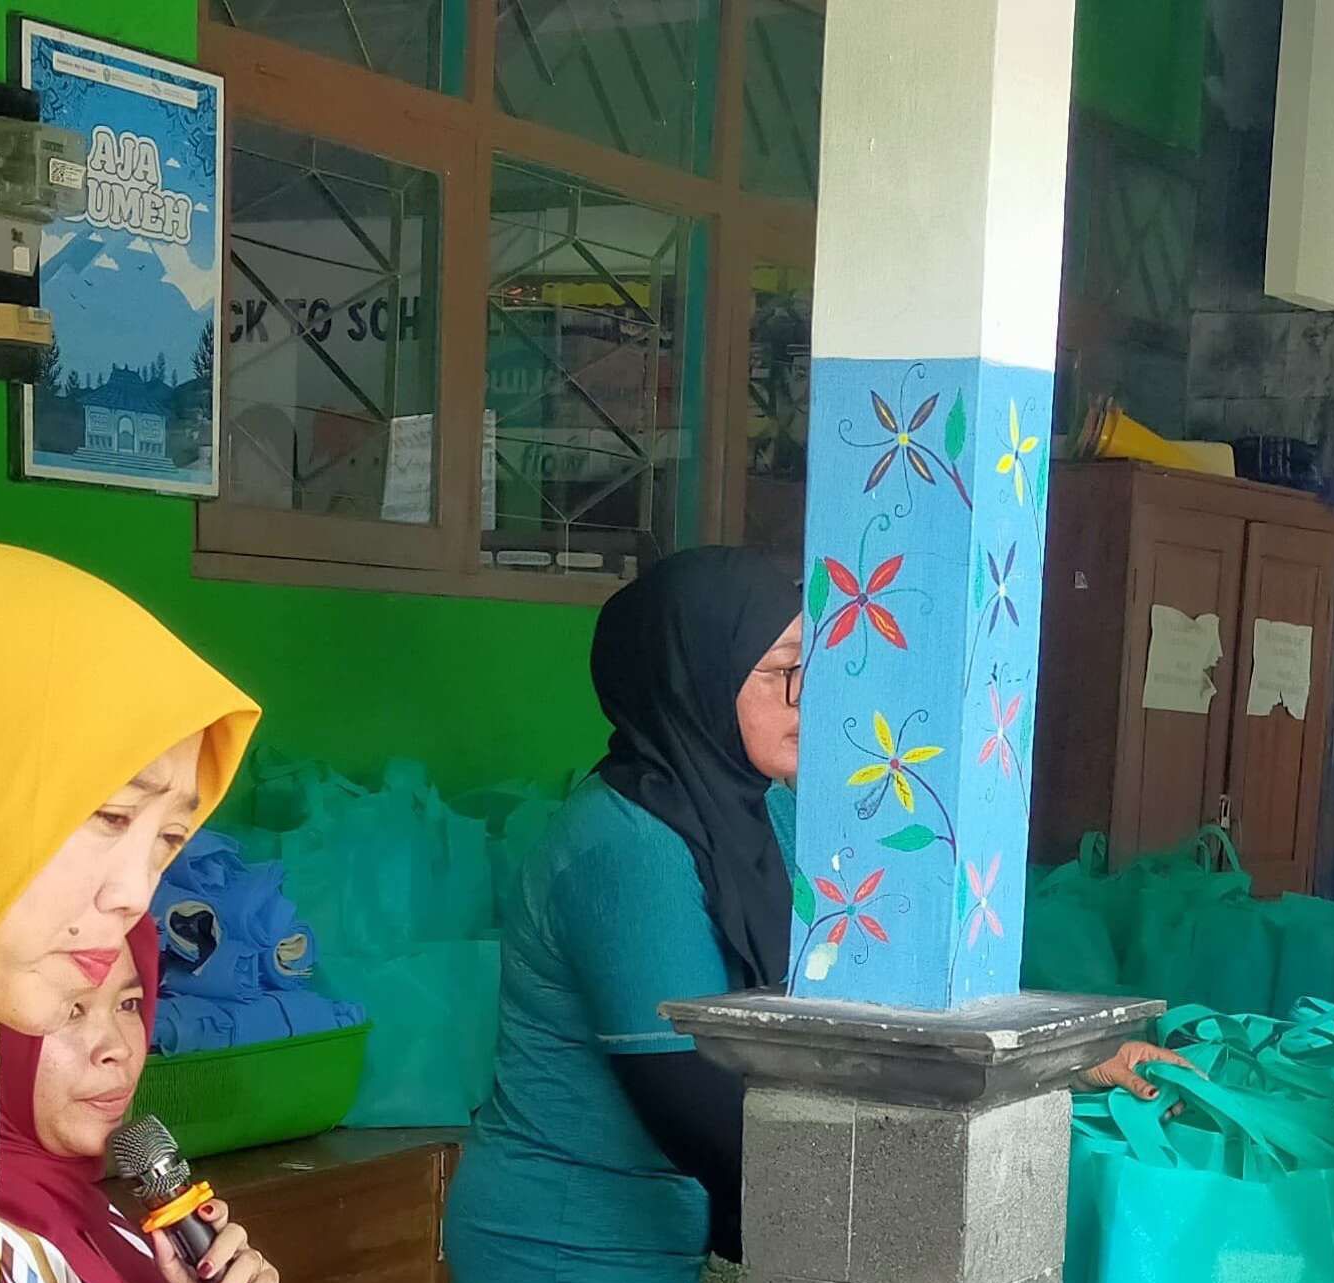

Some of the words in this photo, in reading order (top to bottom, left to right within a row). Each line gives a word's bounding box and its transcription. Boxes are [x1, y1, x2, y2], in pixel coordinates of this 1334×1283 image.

[89, 128, 160, 185] AJA
[87, 176, 190, 241] UMÉH
[284, 298, 332, 342] TO
